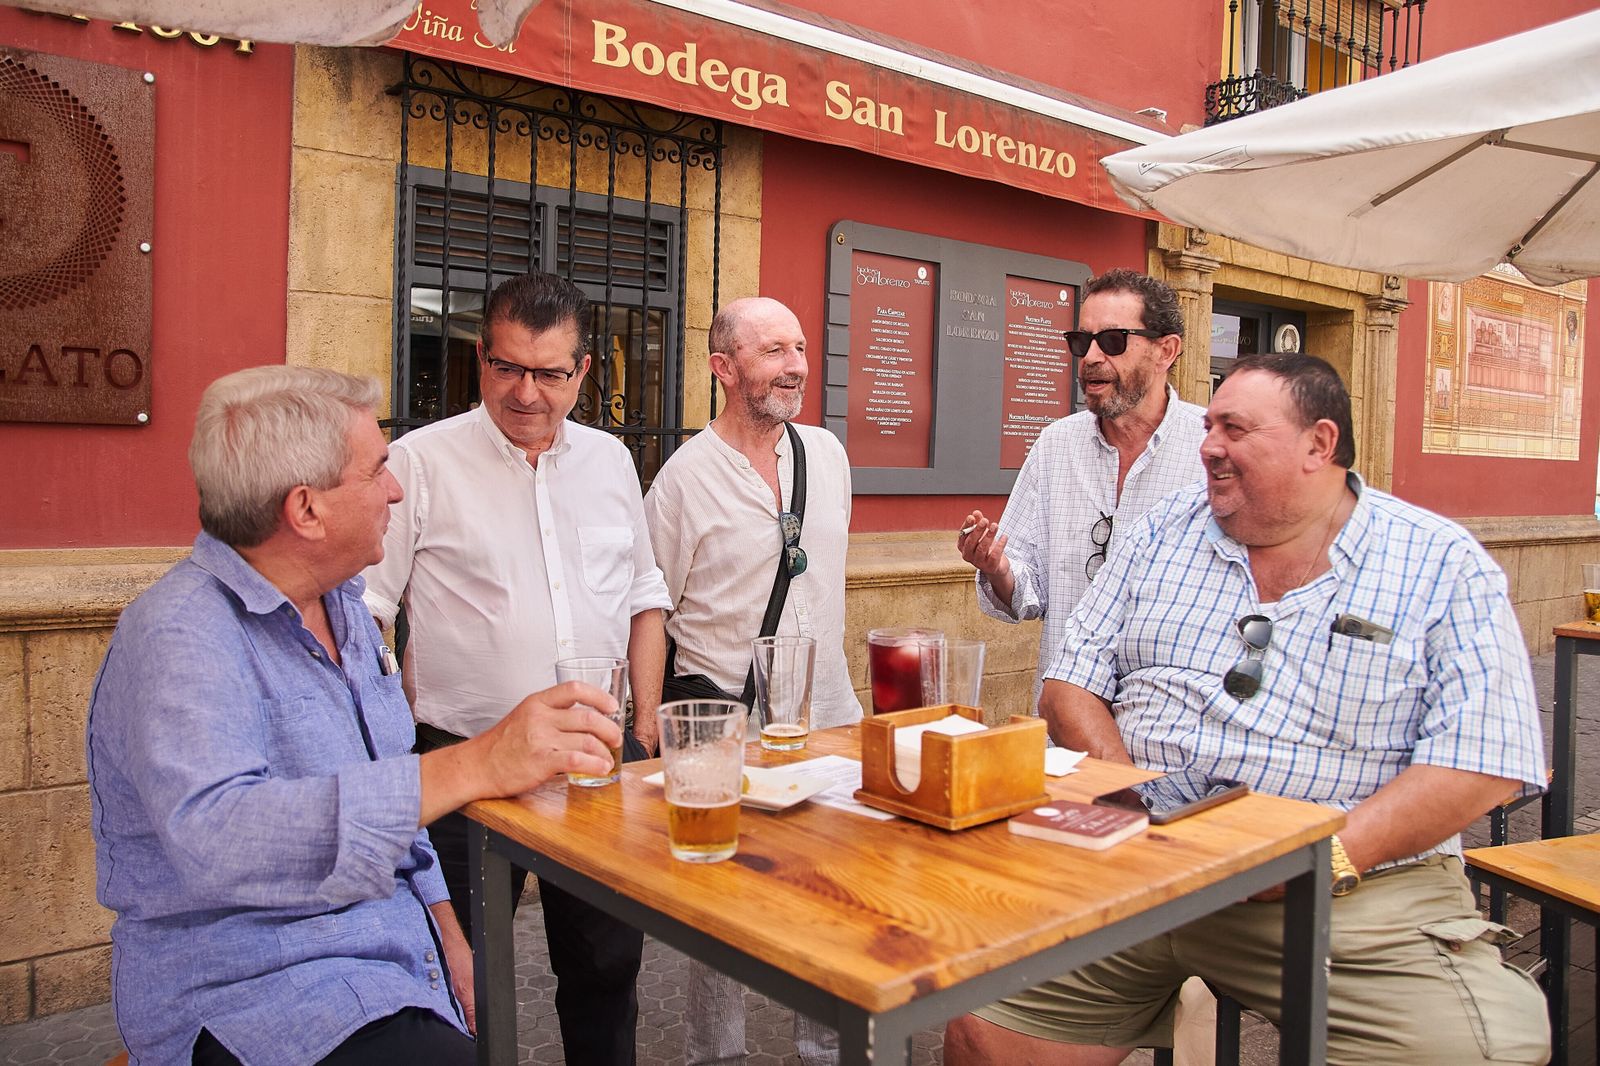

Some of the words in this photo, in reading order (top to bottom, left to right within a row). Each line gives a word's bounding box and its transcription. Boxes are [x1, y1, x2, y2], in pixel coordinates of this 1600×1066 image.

[591, 19, 790, 111] Bodega
[825, 79, 905, 136] San
[934, 108, 1077, 179] Lorenzo
[946, 323, 1000, 342] LORENZO
[961, 309, 985, 323] SAN
[0, 344, 143, 391] ATO
